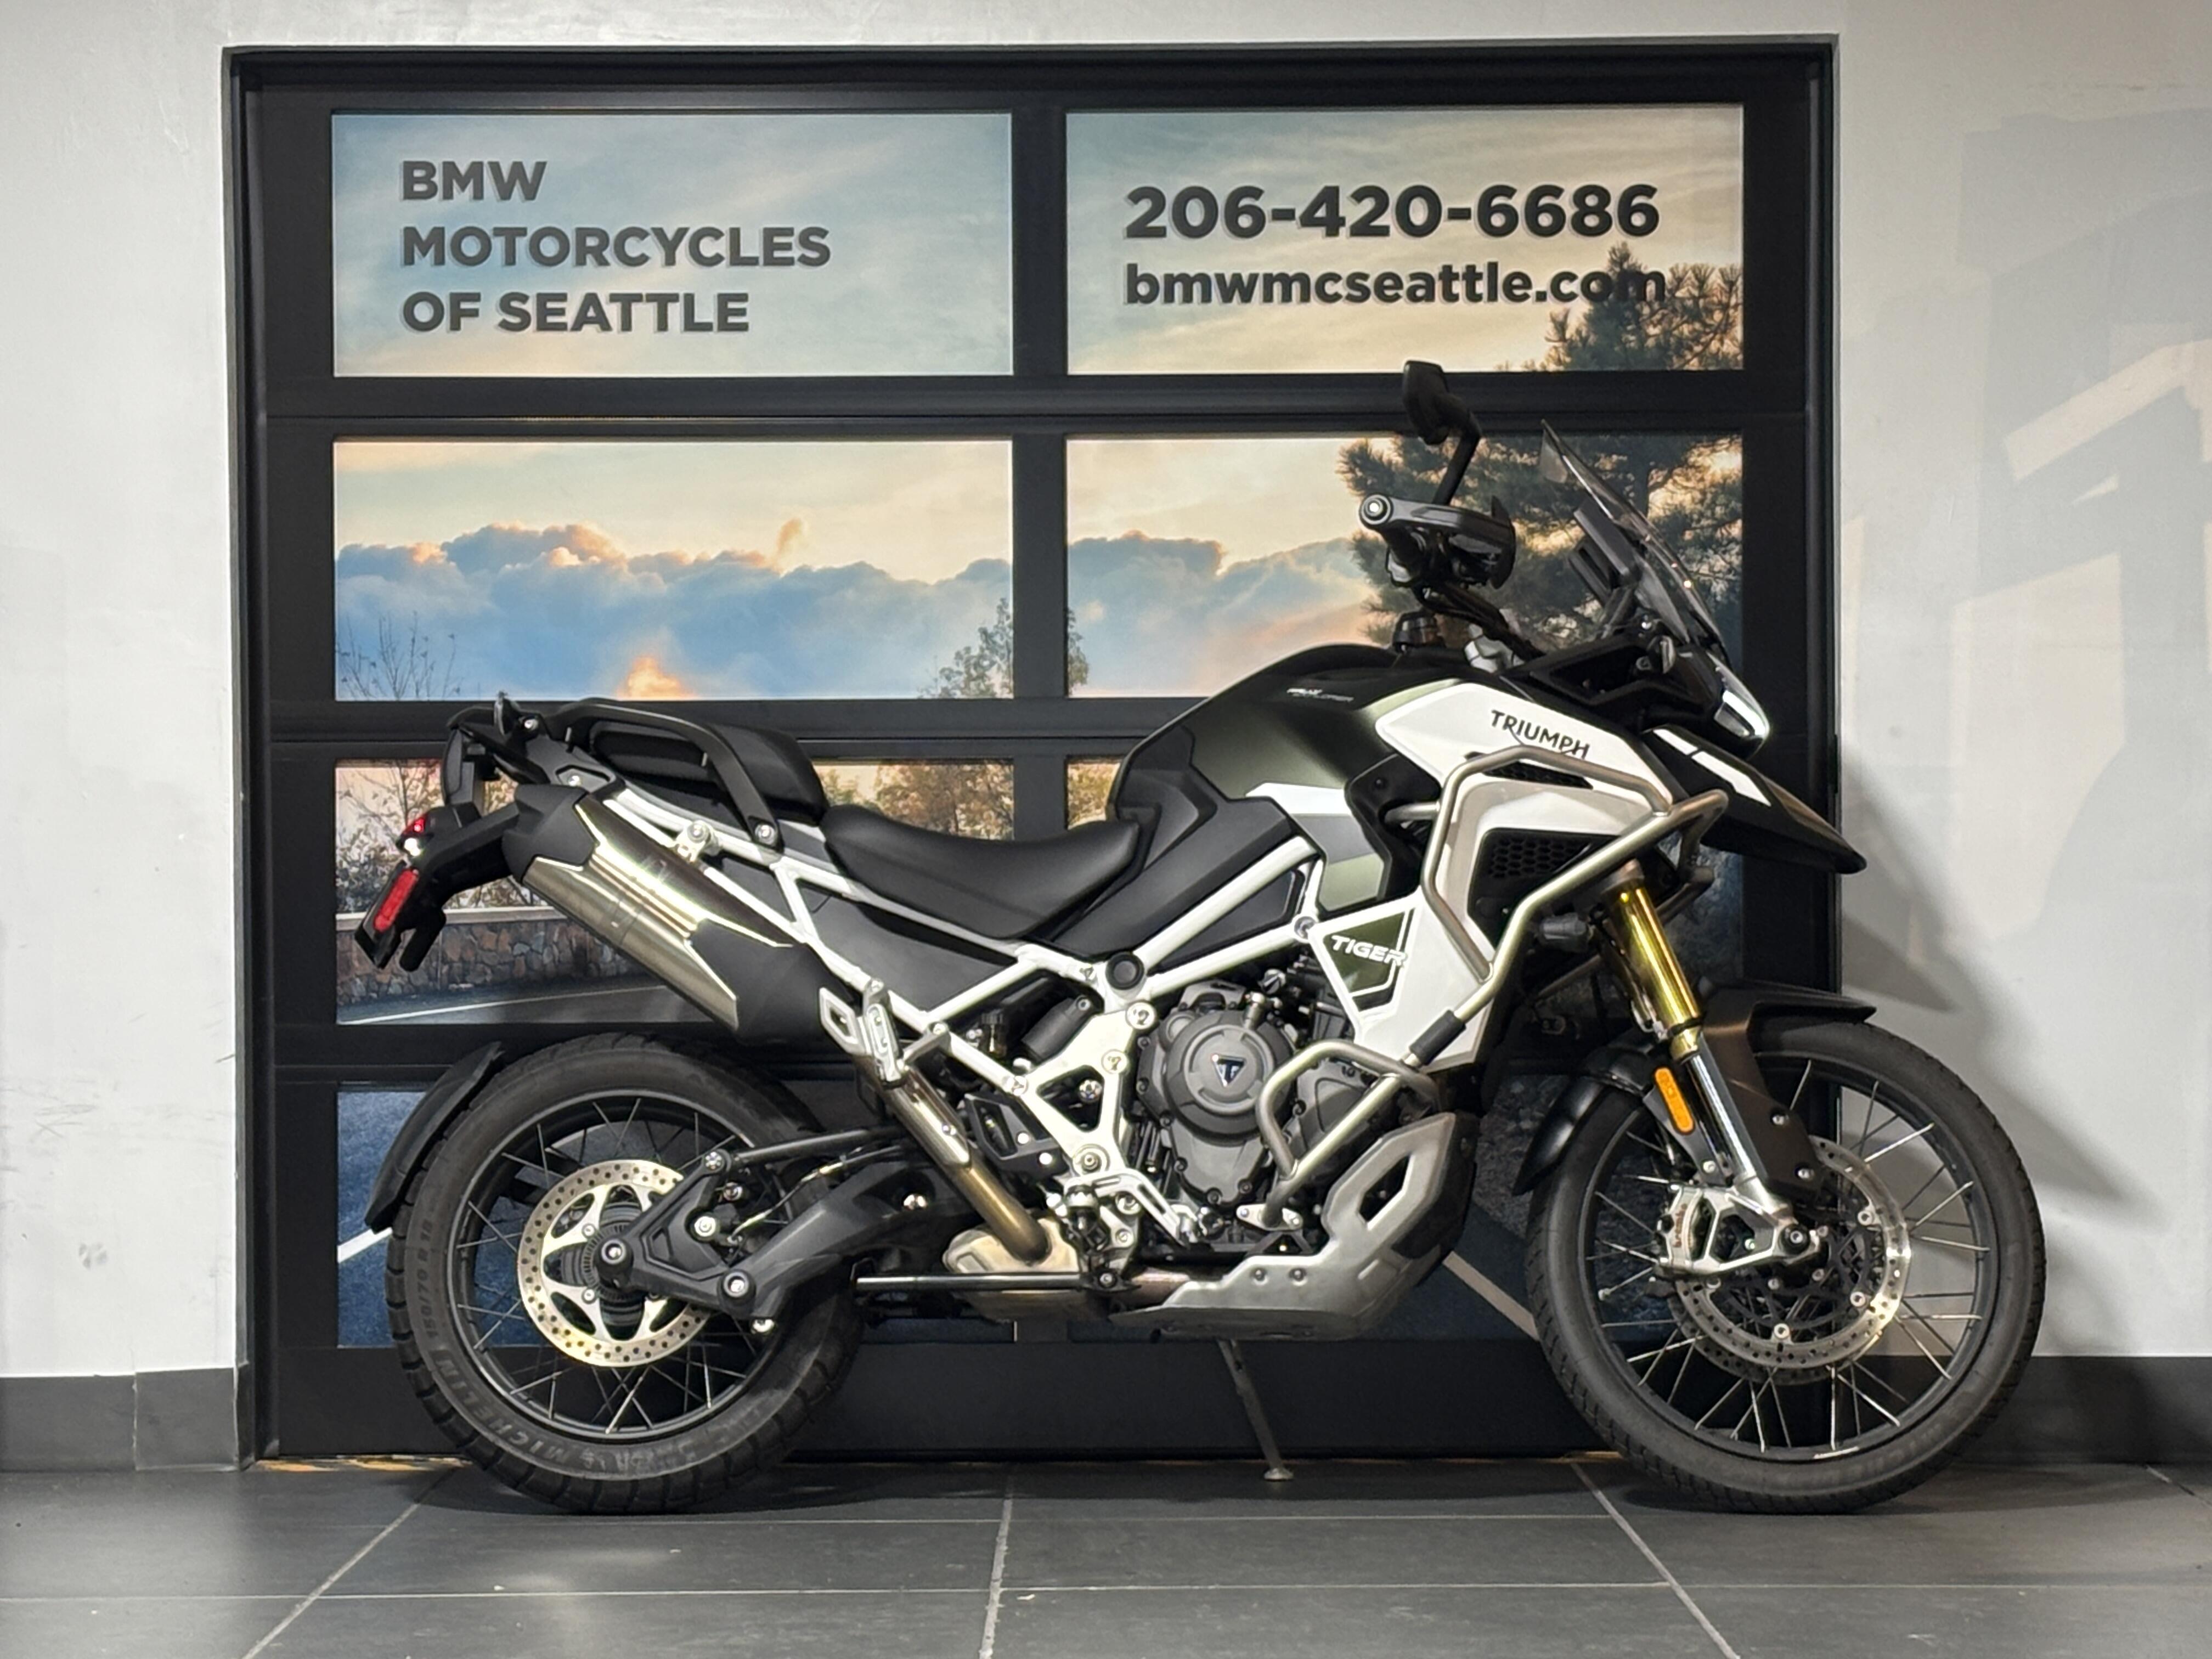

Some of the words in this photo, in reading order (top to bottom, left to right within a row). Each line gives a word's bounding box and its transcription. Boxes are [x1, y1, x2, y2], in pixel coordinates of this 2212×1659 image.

[402, 161, 547, 201] BMW
[1124, 183, 1660, 239] 206-420-6686
[402, 226, 831, 268] MOTORCYCLES
[1125, 262, 1666, 305] bmwmcseattle.com
[402, 291, 481, 334] OF
[496, 291, 749, 333] SEATTLE
[1491, 709, 1590, 760] TRIUMPH
[1330, 935, 1408, 967] TIGER
[436, 1359, 569, 1464] MICHELIN
